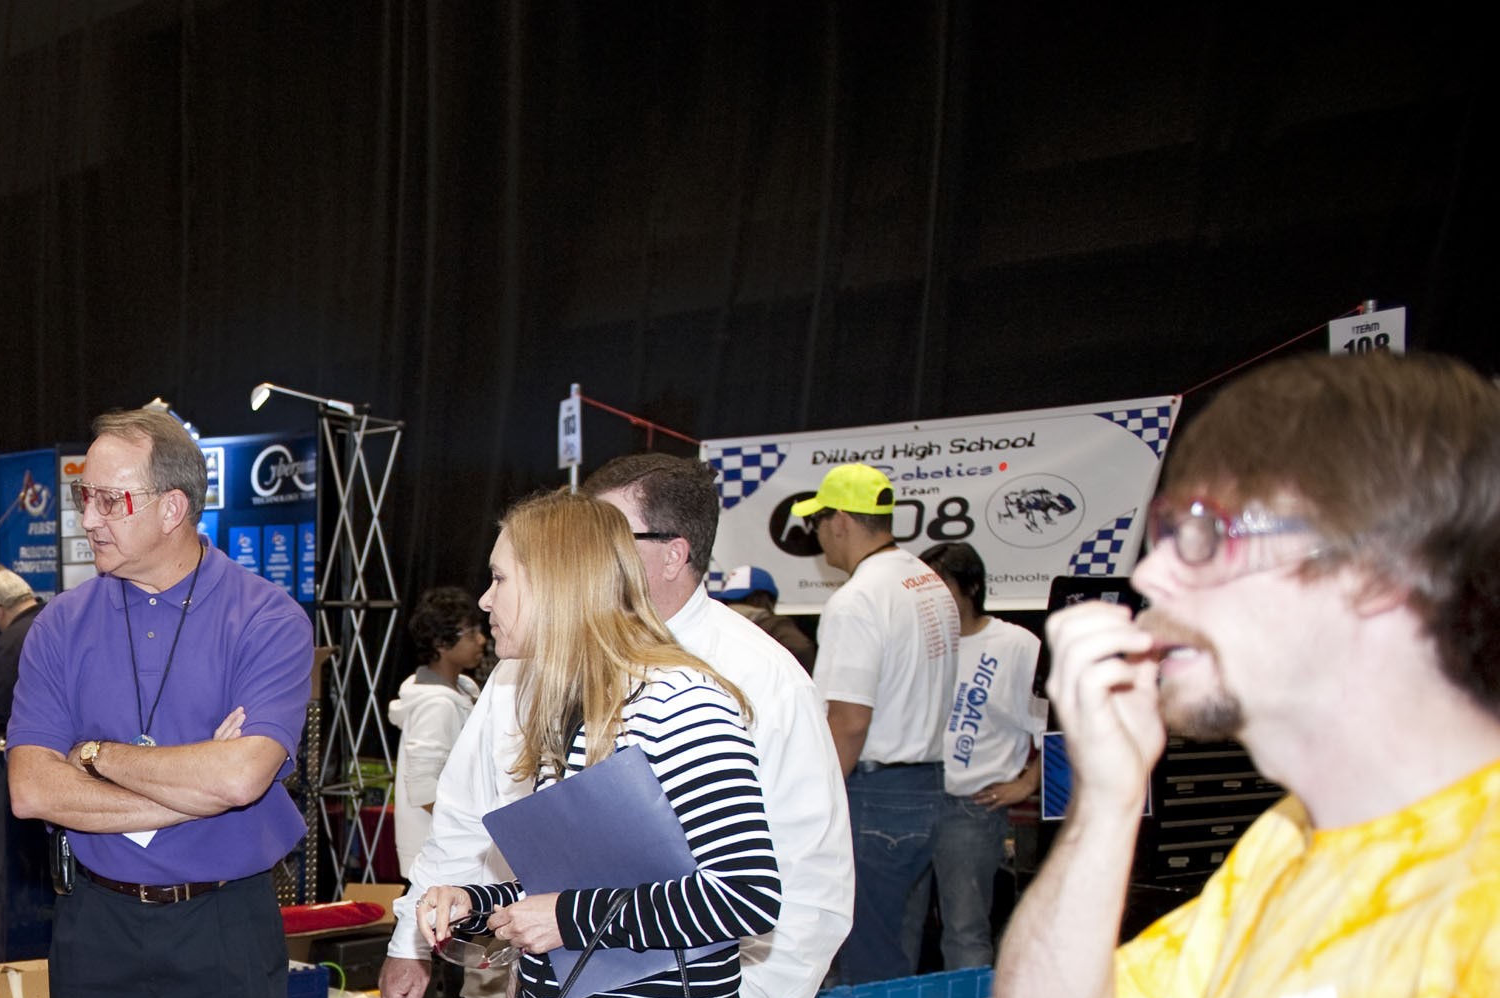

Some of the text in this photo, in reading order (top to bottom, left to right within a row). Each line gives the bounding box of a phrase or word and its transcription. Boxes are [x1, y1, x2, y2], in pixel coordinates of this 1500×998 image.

[811, 432, 1036, 466] Dillard High School
[901, 486, 940, 497] Team
